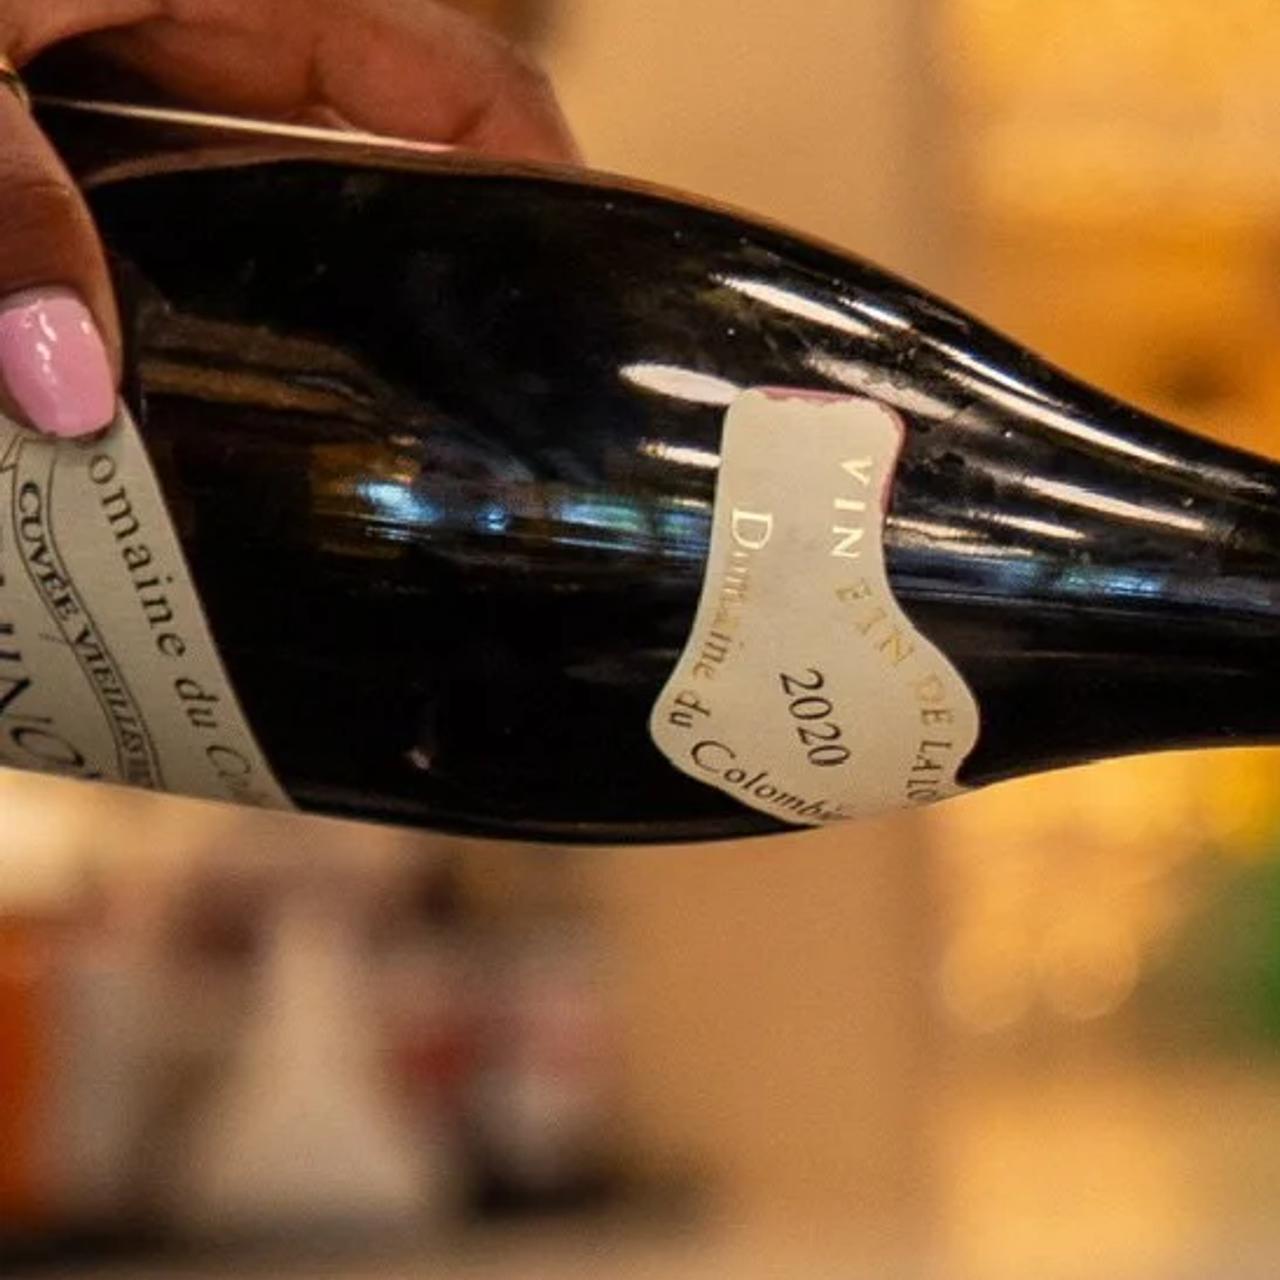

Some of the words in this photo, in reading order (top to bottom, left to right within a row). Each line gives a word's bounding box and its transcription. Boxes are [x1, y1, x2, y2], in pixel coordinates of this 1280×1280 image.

[19, 481, 79, 622] CUVÉE
[831, 455, 873, 560] VIN
[88, 454, 187, 658] omaine
[174, 676, 220, 728] du
[668, 688, 711, 728] du
[779, 668, 851, 767] 2020
[911, 671, 953, 726] DE
[911, 739, 953, 772] LA
